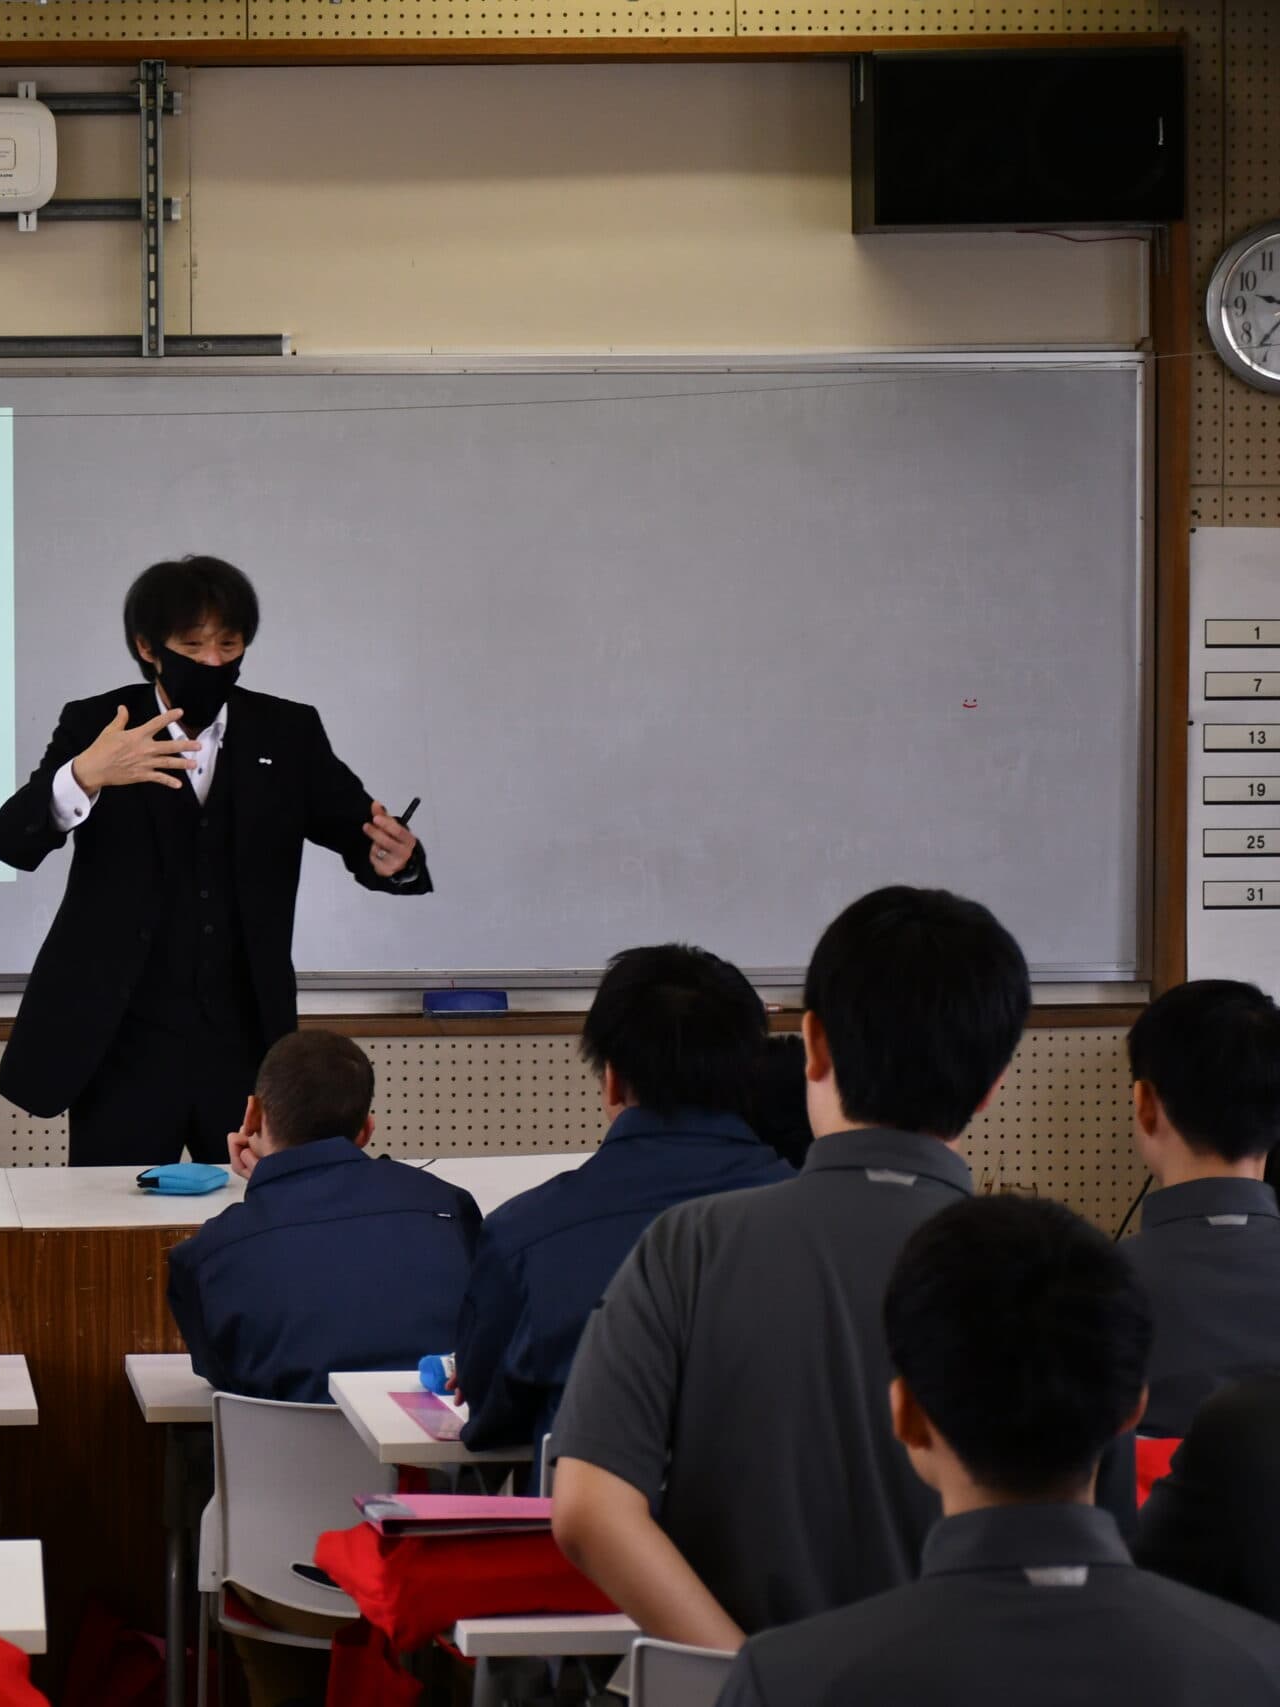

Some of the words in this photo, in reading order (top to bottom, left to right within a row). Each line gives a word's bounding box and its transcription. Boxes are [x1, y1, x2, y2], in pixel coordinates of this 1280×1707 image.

[1261, 252, 1273, 271] 11
[1240, 270, 1257, 291] 10
[1234, 296, 1246, 316] 9
[1241, 322, 1252, 344] 8
[1254, 626, 1260, 641] 1
[1253, 678, 1263, 693] 7
[1248, 730, 1266, 745] 13
[1248, 783, 1266, 797] 19
[1246, 835, 1265, 849] 25
[1246, 888, 1264, 902] 31
